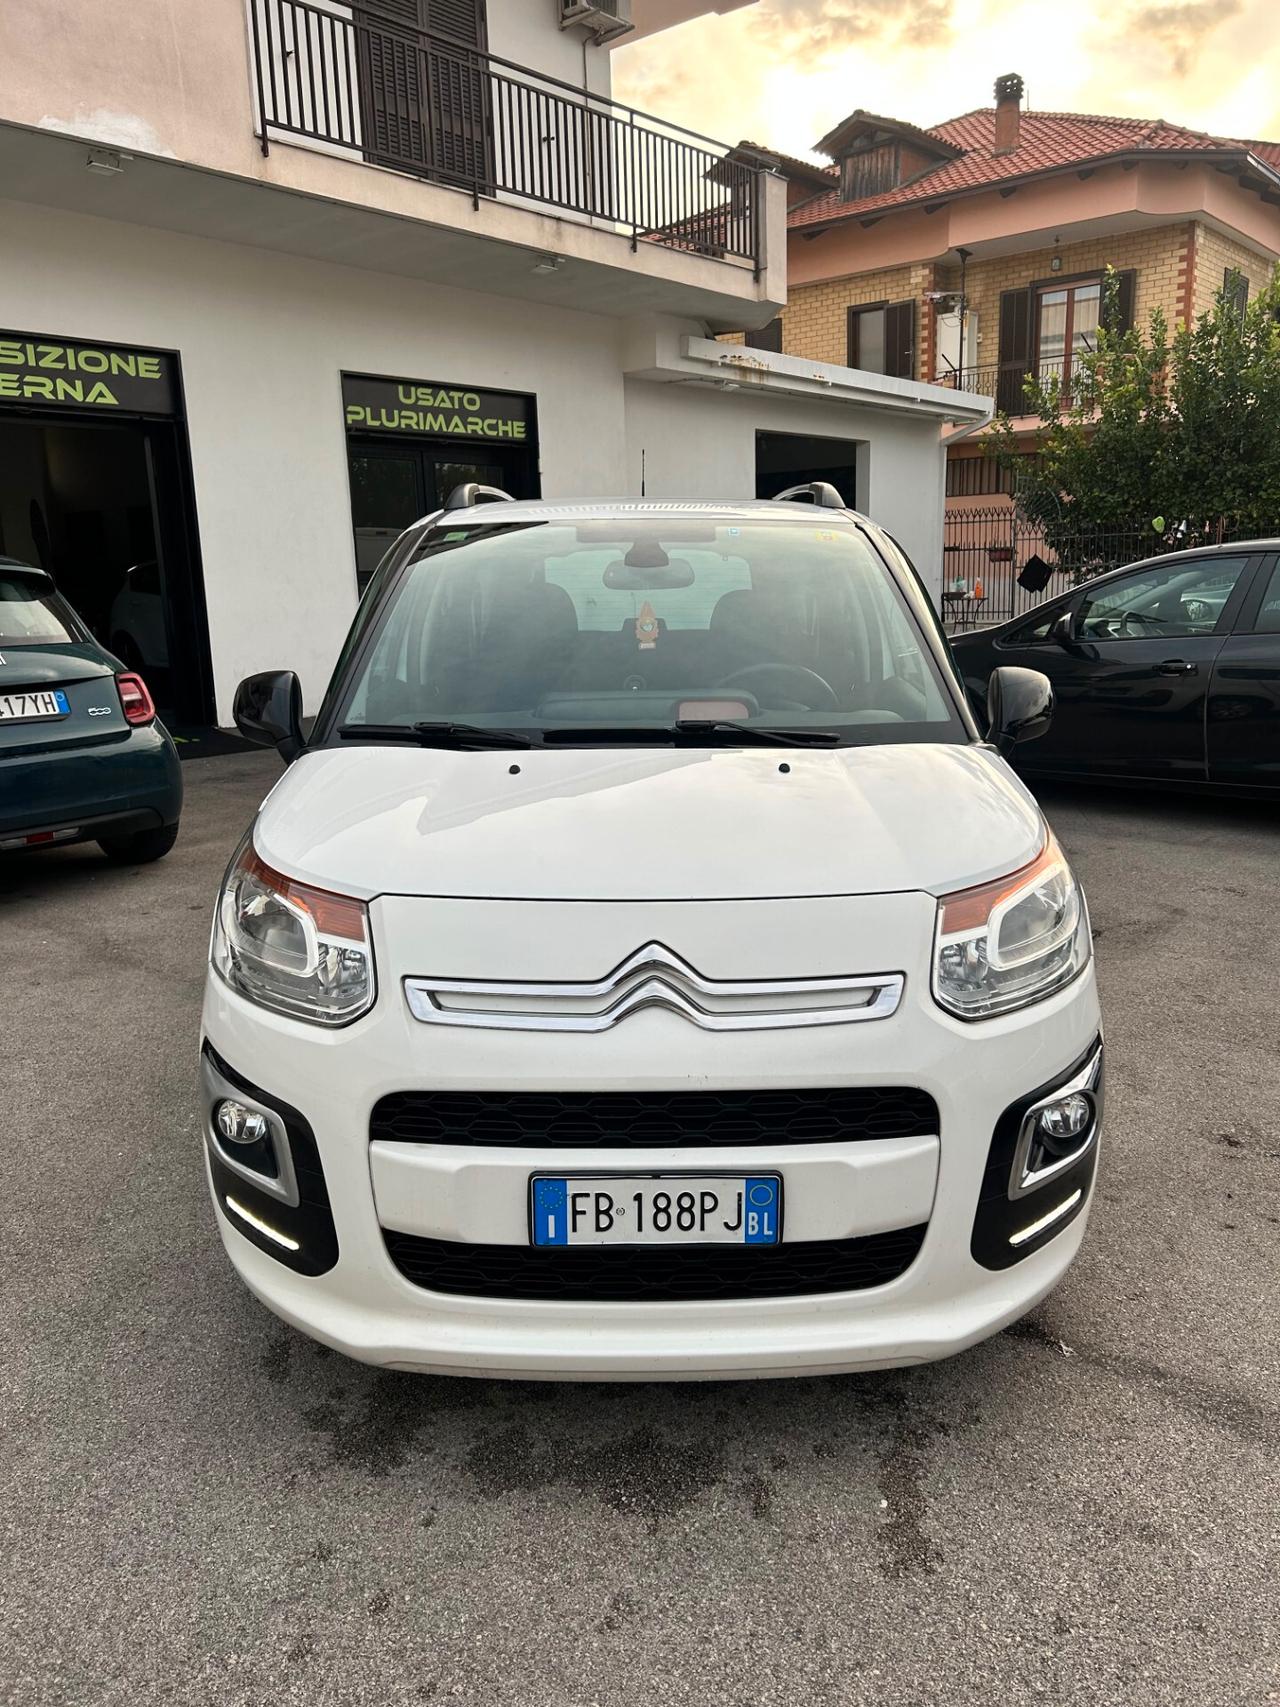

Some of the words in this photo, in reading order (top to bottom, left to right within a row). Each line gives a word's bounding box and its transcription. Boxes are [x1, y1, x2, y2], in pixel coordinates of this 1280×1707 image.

[0, 341, 162, 379] SIZIONE
[0, 372, 120, 405] ERNA
[398, 385, 481, 411] USATO
[346, 405, 527, 439] PLURIMARCHE
[0, 693, 57, 718] 17YH
[571, 1192, 615, 1233] FB
[632, 1191, 743, 1232] 188PJ
[748, 1212, 773, 1236] BL
